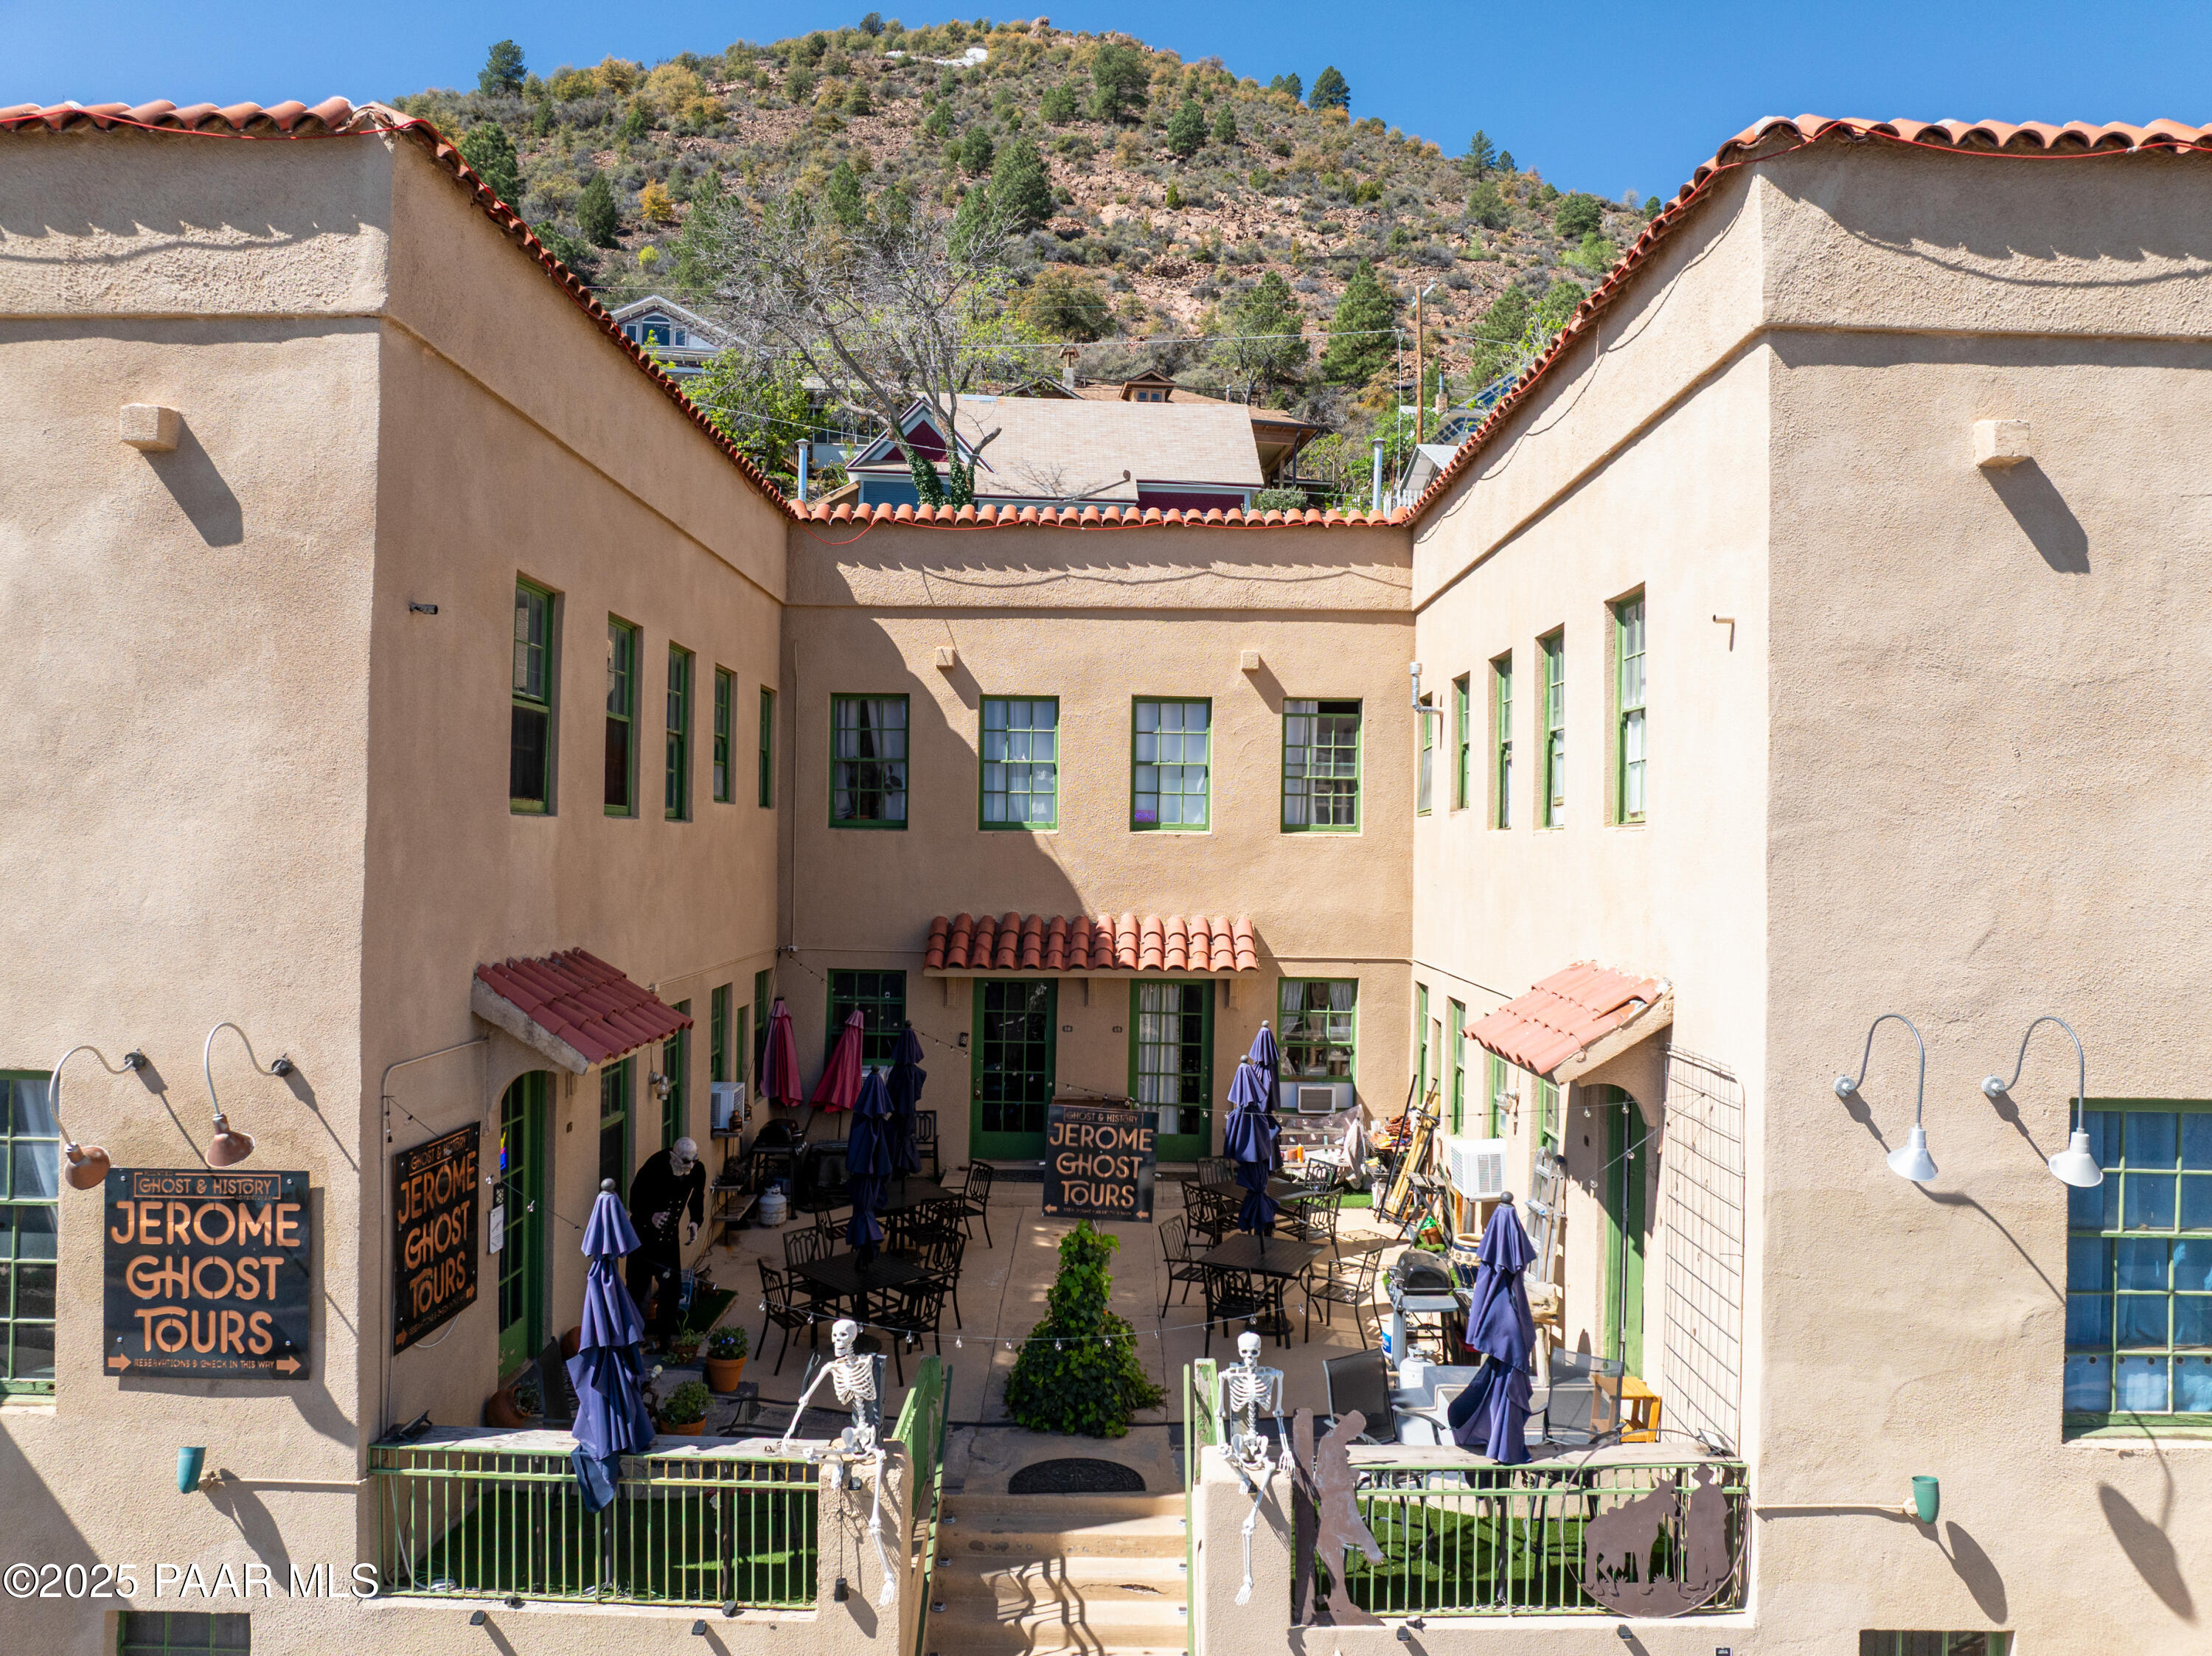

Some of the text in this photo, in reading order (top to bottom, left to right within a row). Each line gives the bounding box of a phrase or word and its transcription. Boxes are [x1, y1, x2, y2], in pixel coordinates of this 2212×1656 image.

[1066, 1111, 1138, 1123] GHOST & HISTORY
[411, 1148, 435, 1170] GHOST
[443, 1135, 466, 1156] HTORY
[1049, 1122, 1154, 1152] JEROME
[1056, 1152, 1143, 1180] GHOST
[138, 1177, 272, 1195] GHOST & HISTORY
[397, 1150, 476, 1225] JEROME
[1060, 1180, 1135, 1208] TOURS
[111, 1200, 301, 1247] JEROME
[405, 1200, 470, 1270] GHOST
[125, 1255, 285, 1300] GHOST
[409, 1250, 466, 1319] TOURS
[135, 1305, 274, 1355] TOURS
[133, 1358, 190, 1368] RESERVATIONS
[229, 1360, 238, 1368] IN
[240, 1360, 255, 1369] THIS
[257, 1360, 275, 1369] WAY
